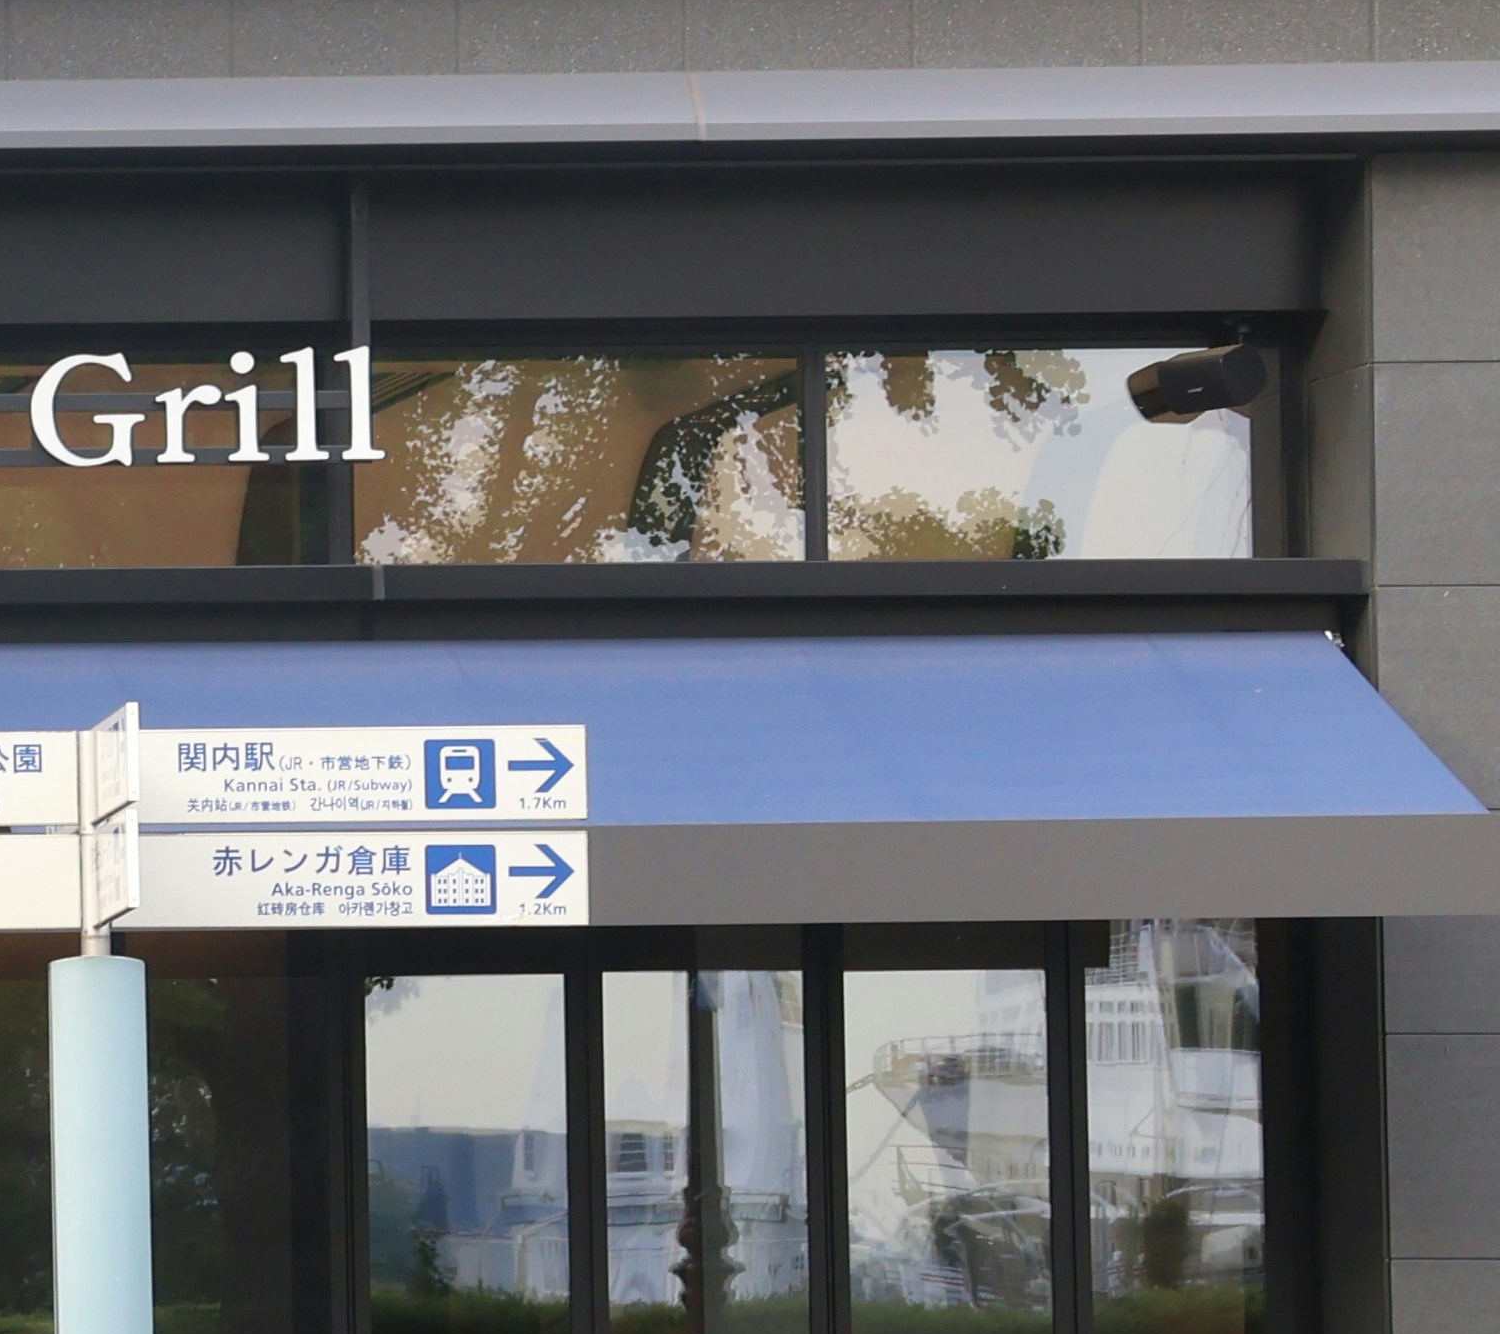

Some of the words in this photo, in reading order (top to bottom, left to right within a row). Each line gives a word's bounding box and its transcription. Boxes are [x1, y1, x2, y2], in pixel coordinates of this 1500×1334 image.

[31, 345, 384, 465] Grill
[224, 778, 283, 792] Kannai
[290, 778, 321, 791] Sta.
[328, 779, 412, 793] (JR/Subway)
[518, 797, 567, 810] 1.7Km
[213, 845, 411, 876] 赤レンガ倉庫
[272, 882, 364, 900] Aka-Renga
[372, 882, 412, 896] Sōko
[519, 902, 567, 916] 1.2Km
